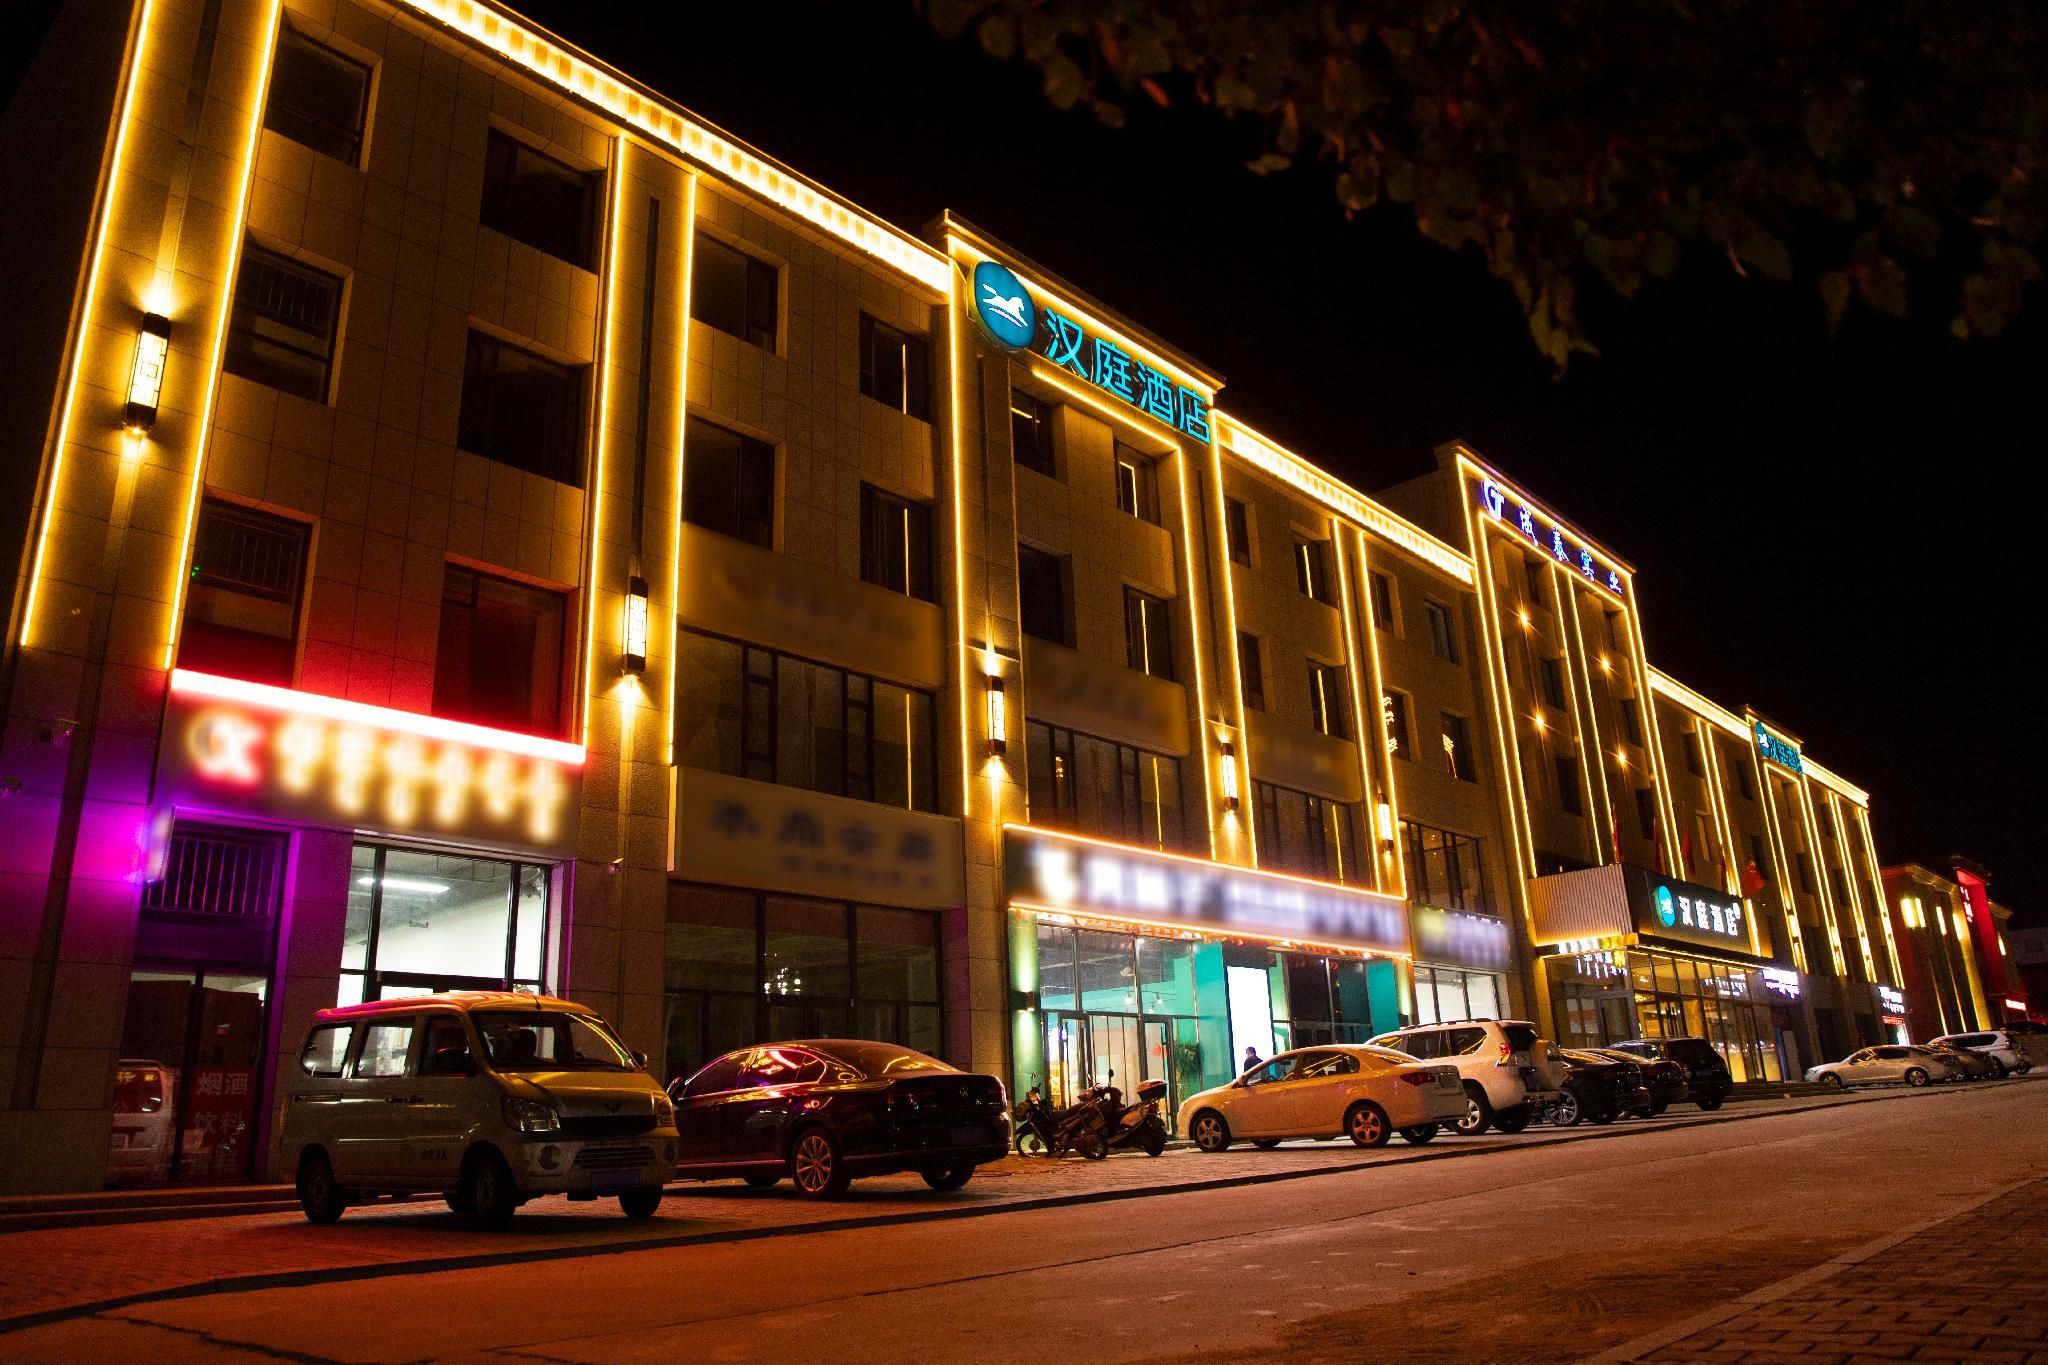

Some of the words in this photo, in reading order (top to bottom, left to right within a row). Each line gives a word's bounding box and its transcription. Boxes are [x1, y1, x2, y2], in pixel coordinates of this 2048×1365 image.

[1044, 307, 1211, 445] 汉庭酒店
[1678, 895, 1738, 937] 汉庭酒店
[197, 1071, 249, 1097] 烟酒
[191, 1110, 246, 1137] 饮料
